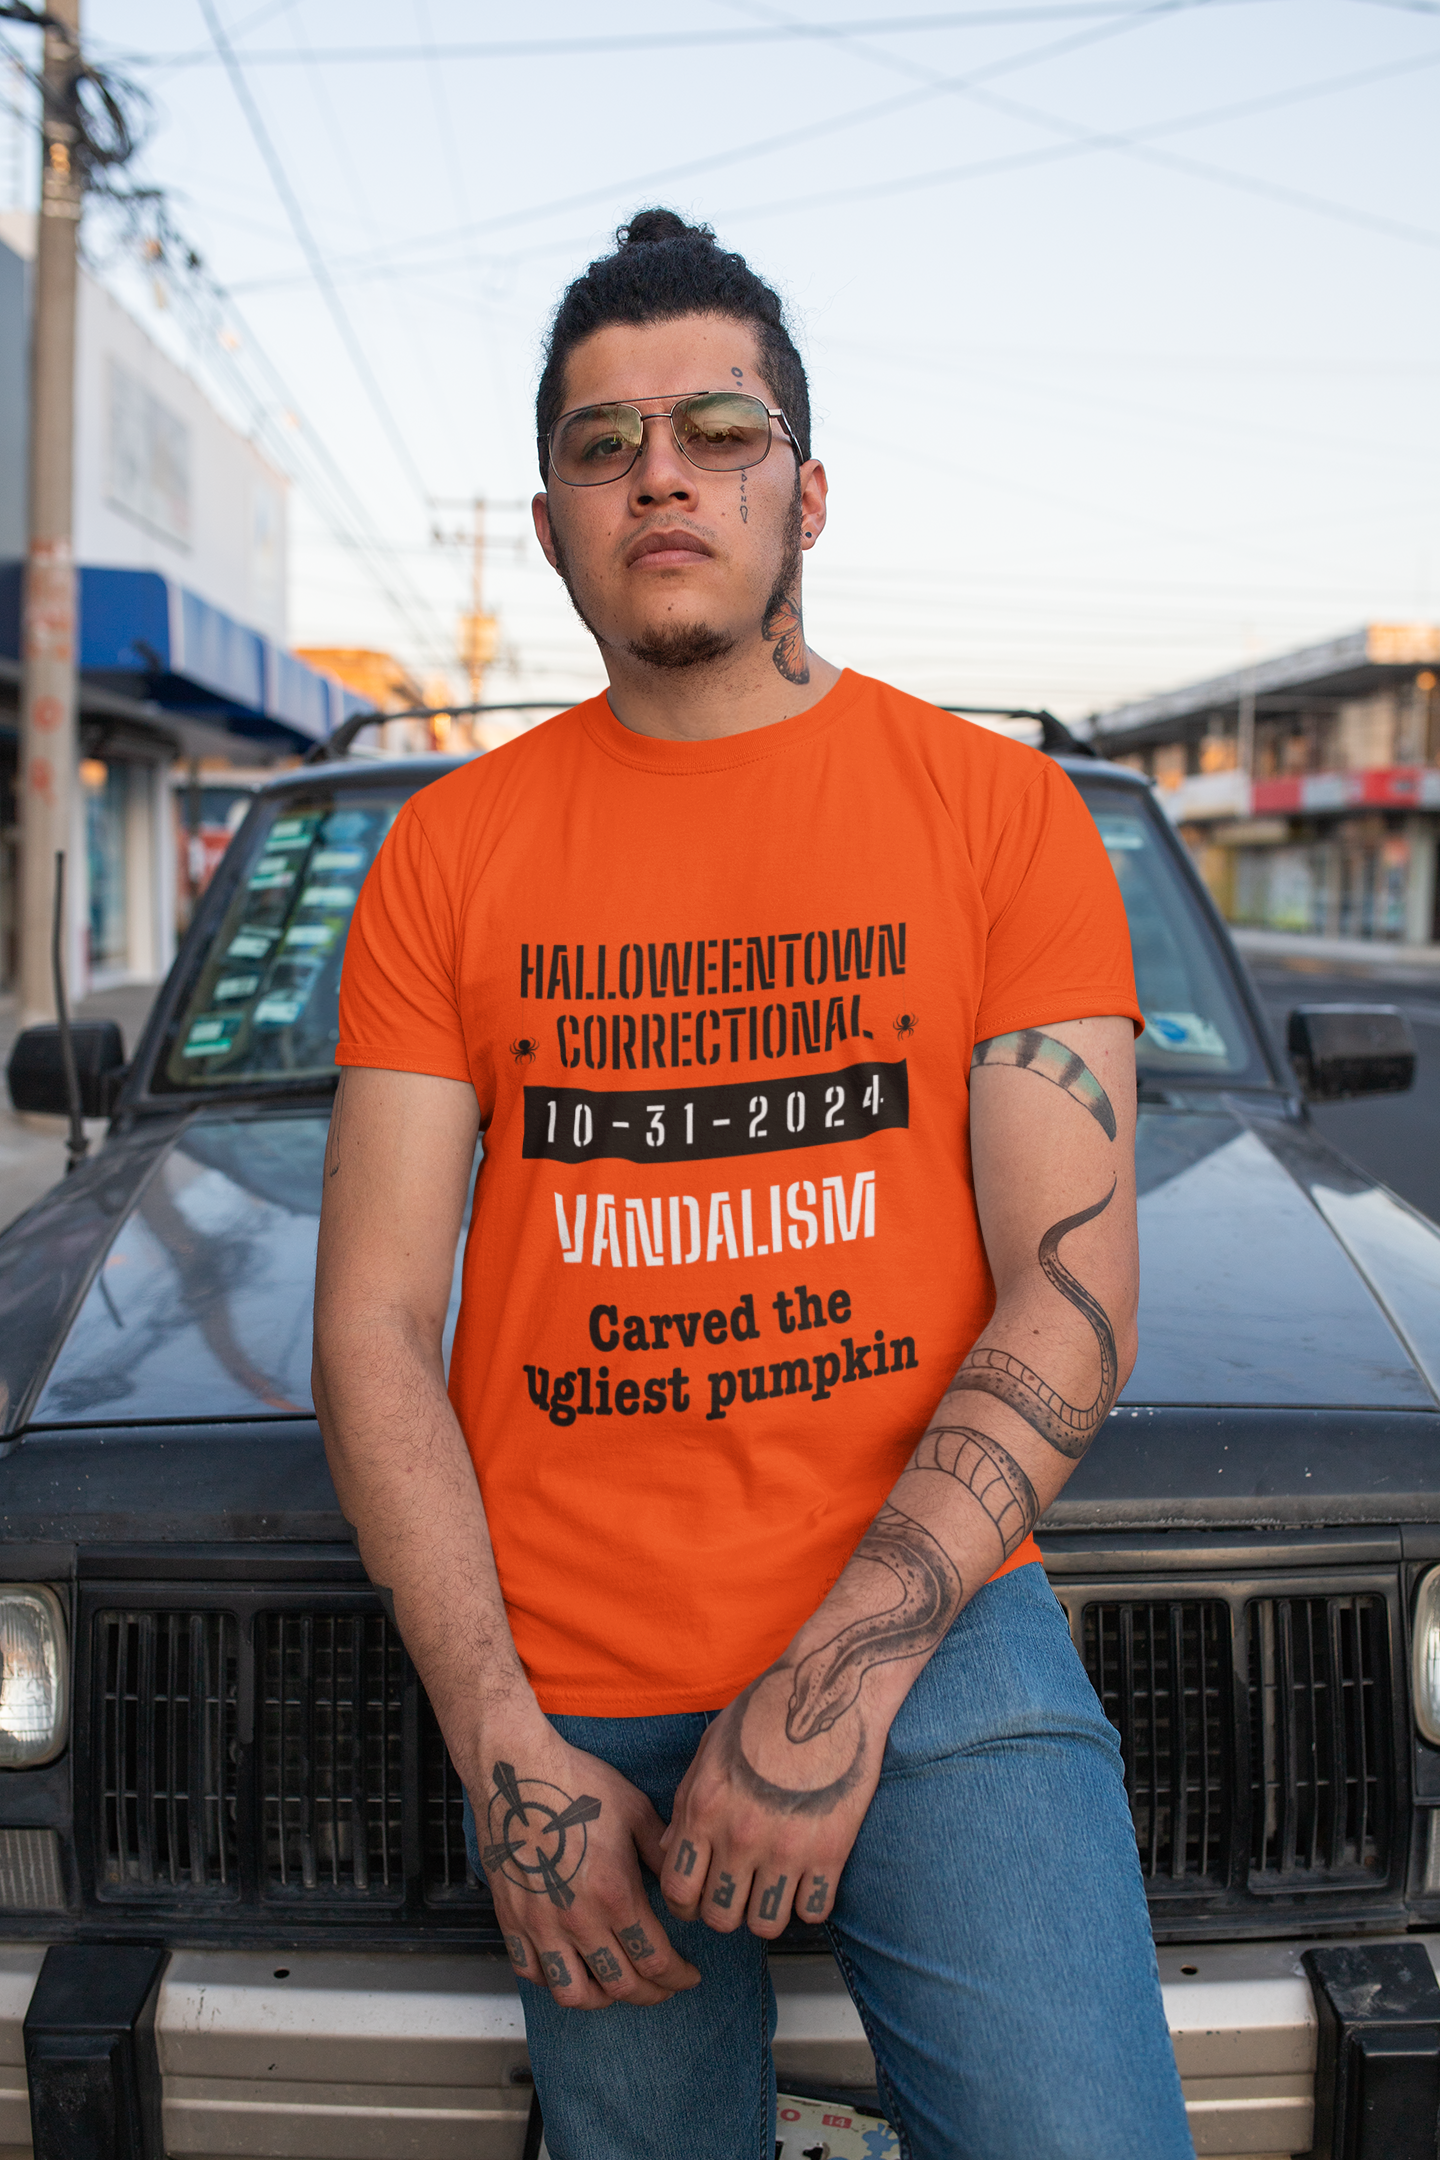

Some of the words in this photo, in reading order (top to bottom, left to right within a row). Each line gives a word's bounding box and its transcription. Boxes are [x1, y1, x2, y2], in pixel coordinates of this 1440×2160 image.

[520, 922, 906, 1000] HALLOWEENTOWN
[556, 994, 874, 1070] CORRECTIONAL
[554, 1170, 876, 1268] VANDALISM
[588, 1293, 761, 1353] Carved
[772, 1285, 852, 1334] the
[705, 1328, 919, 1421] pumpkin
